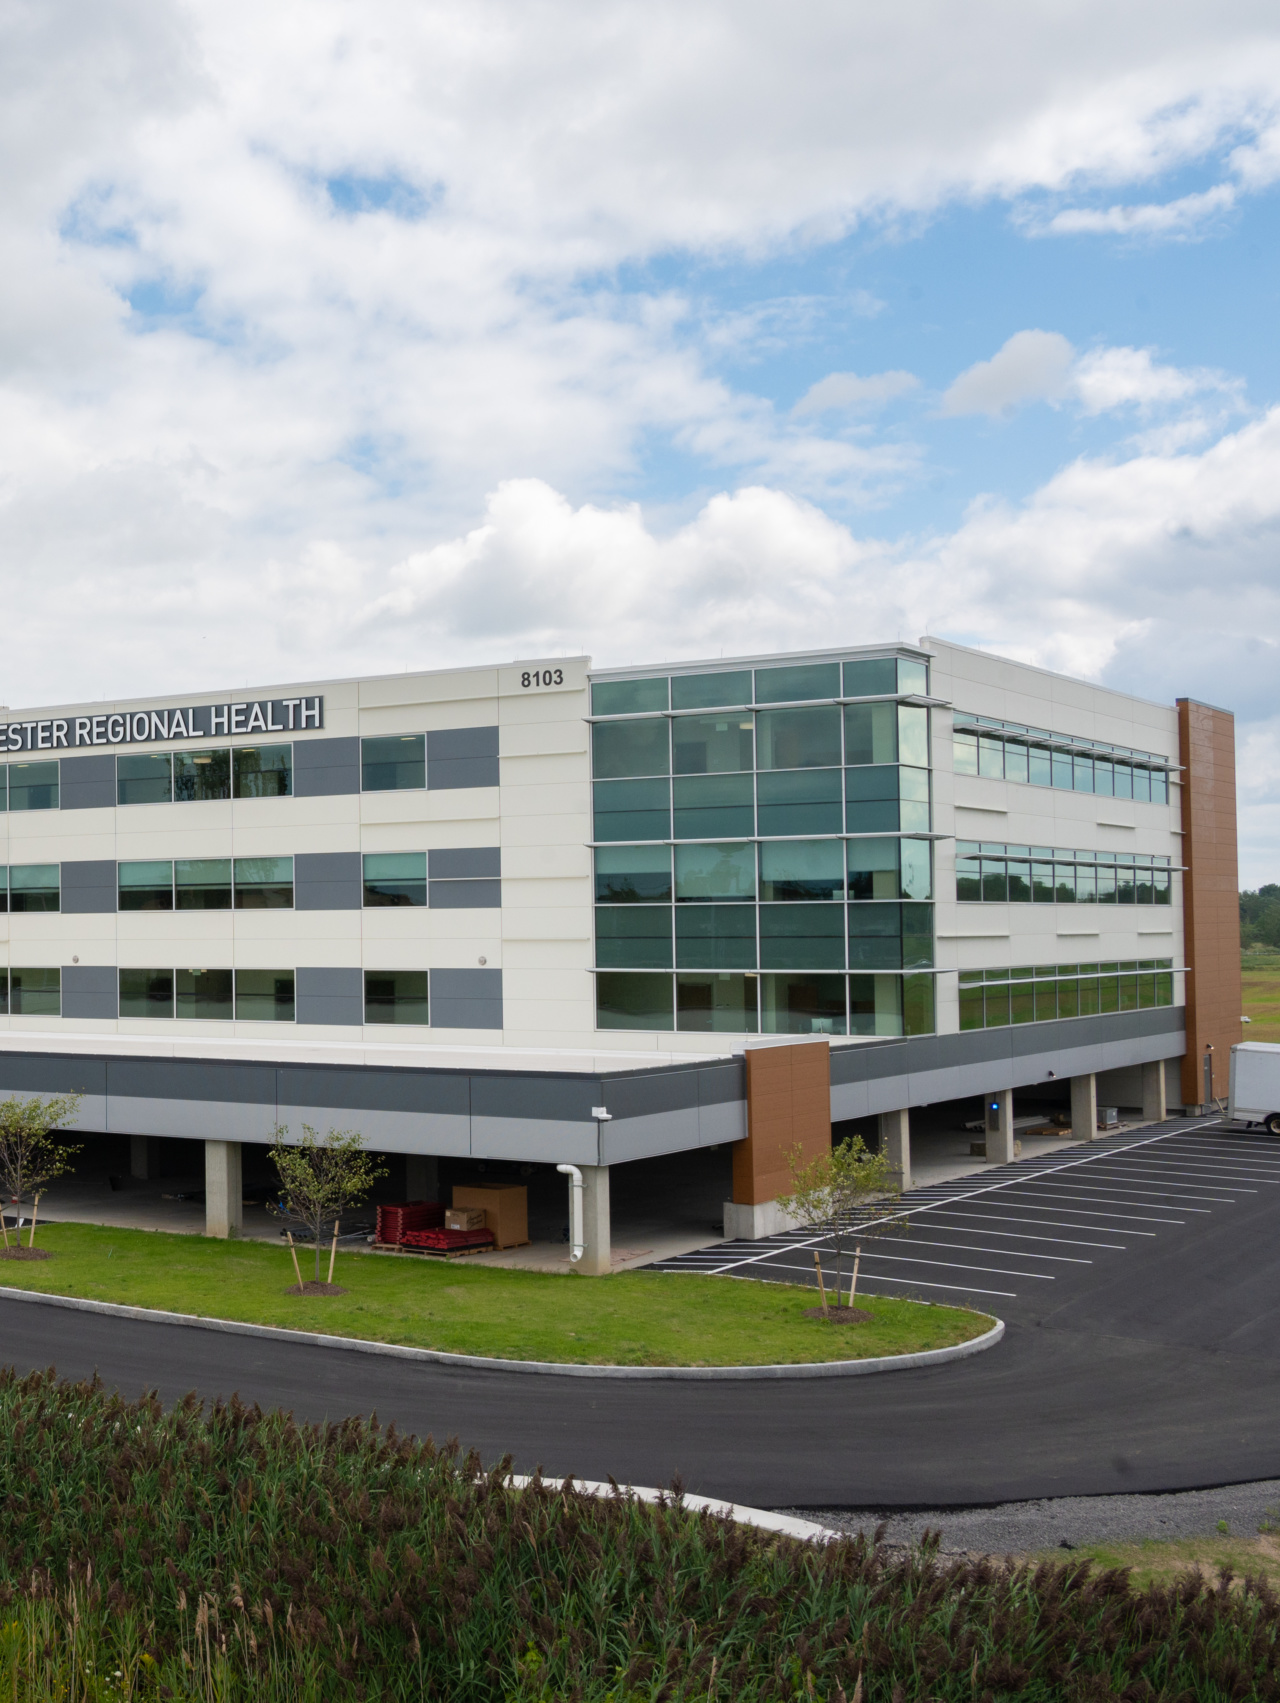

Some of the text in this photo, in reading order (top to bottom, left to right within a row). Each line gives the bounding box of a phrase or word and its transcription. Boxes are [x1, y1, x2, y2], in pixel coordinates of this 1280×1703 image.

[521, 669, 564, 688] 8103
[75, 708, 204, 746] REGIONAL
[211, 697, 320, 735] HEALTH
